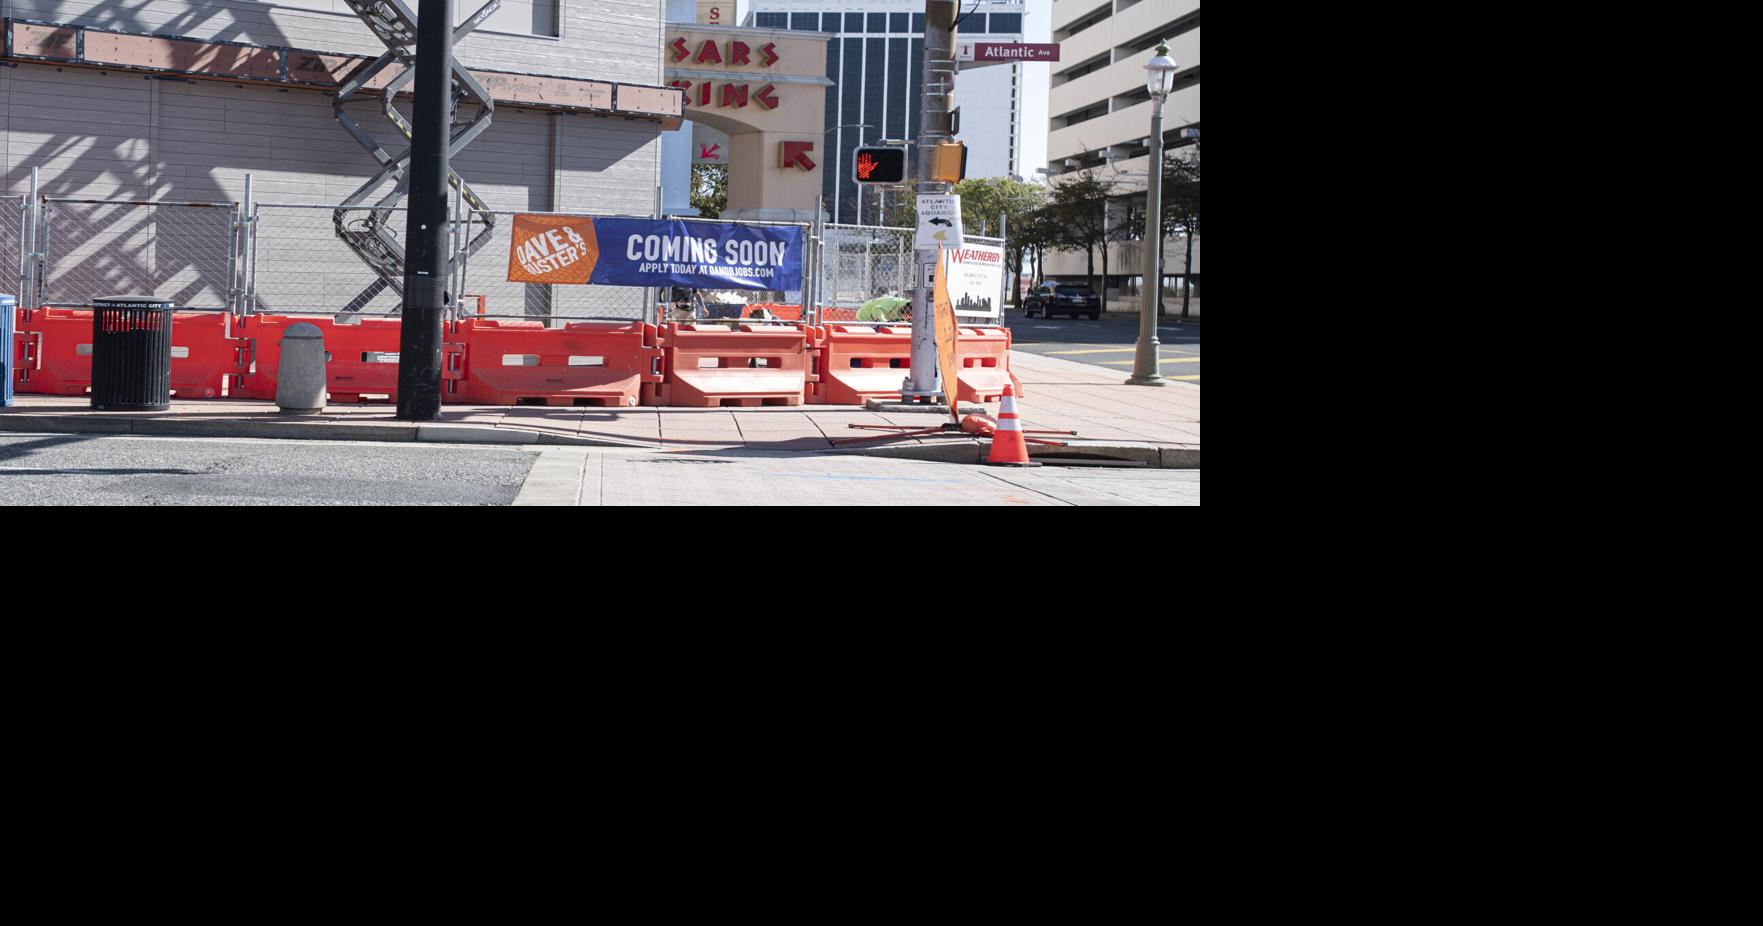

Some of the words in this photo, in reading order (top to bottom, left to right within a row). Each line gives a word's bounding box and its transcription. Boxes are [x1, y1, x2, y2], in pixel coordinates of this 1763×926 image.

[670, 37, 780, 67] SARS
[985, 46, 1034, 58] Atlantic
[517, 228, 570, 266] DAVE
[562, 226, 584, 243] &
[626, 234, 718, 264] COMING
[725, 239, 785, 267] SOON
[951, 249, 1001, 263] WEATHERBY
[639, 263, 669, 273] APPLY
[670, 263, 697, 274] TODAY
[698, 265, 708, 275] AT
